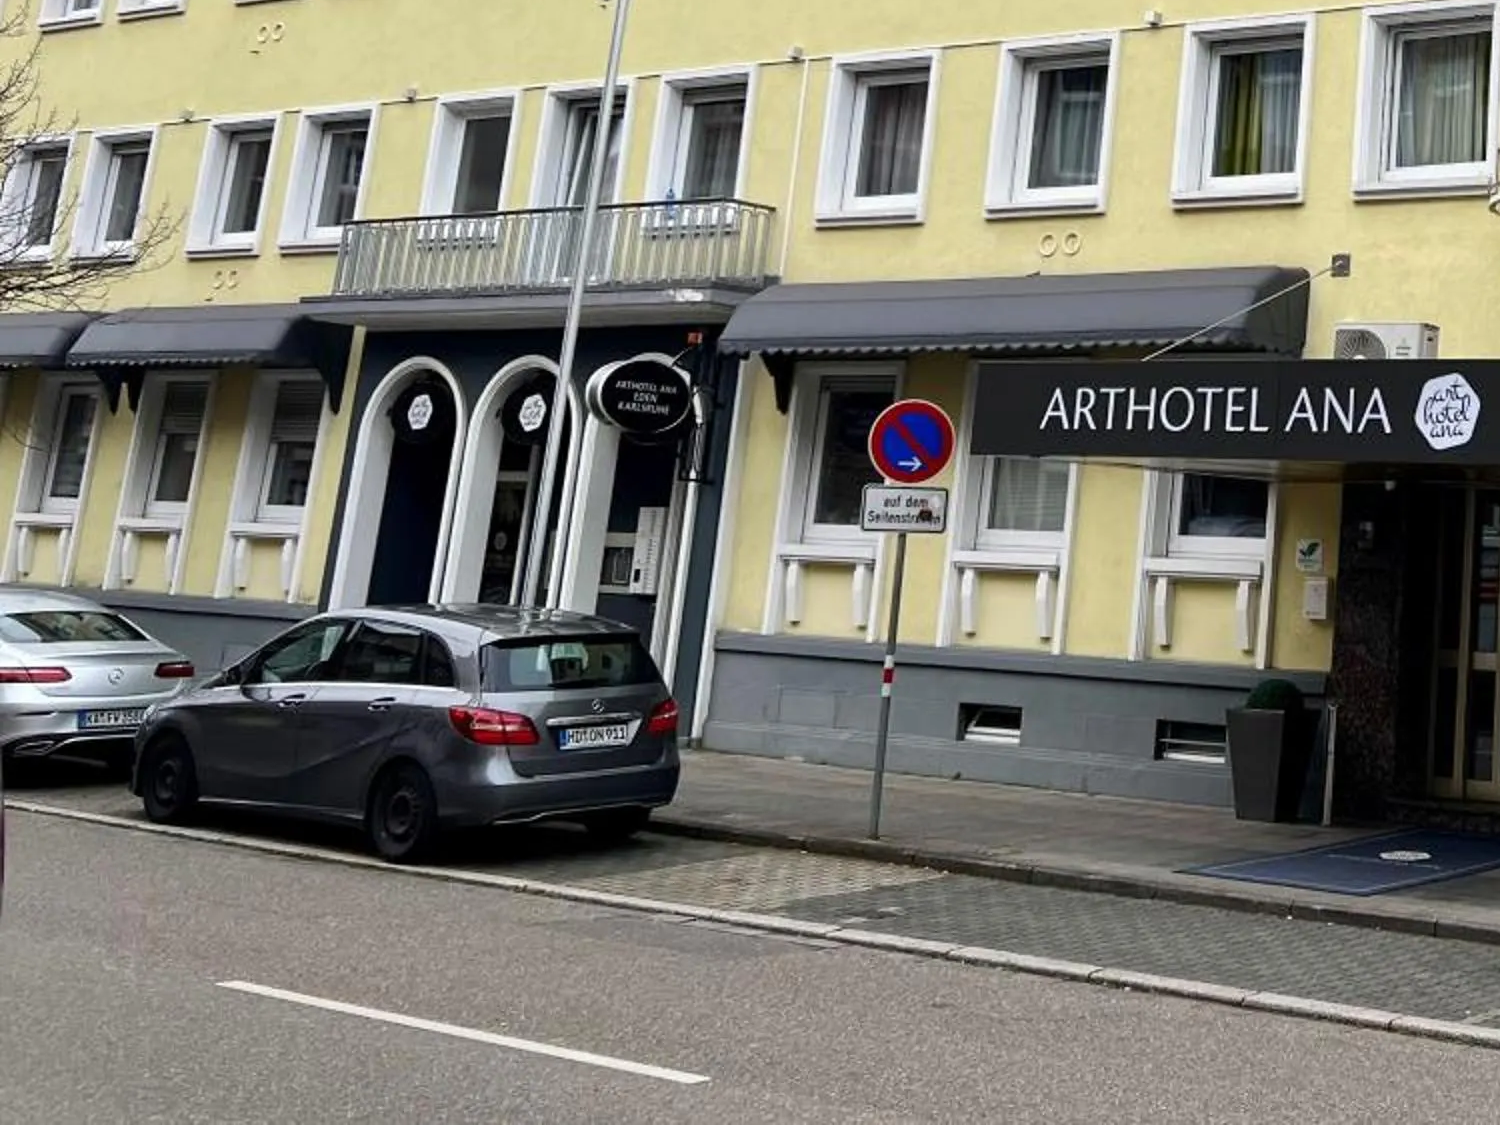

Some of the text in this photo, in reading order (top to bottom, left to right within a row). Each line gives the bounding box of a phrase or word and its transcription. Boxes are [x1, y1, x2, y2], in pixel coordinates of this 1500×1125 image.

[1040, 386, 1392, 434] ARTHOTEL ANA
[883, 495, 929, 508] auf dem
